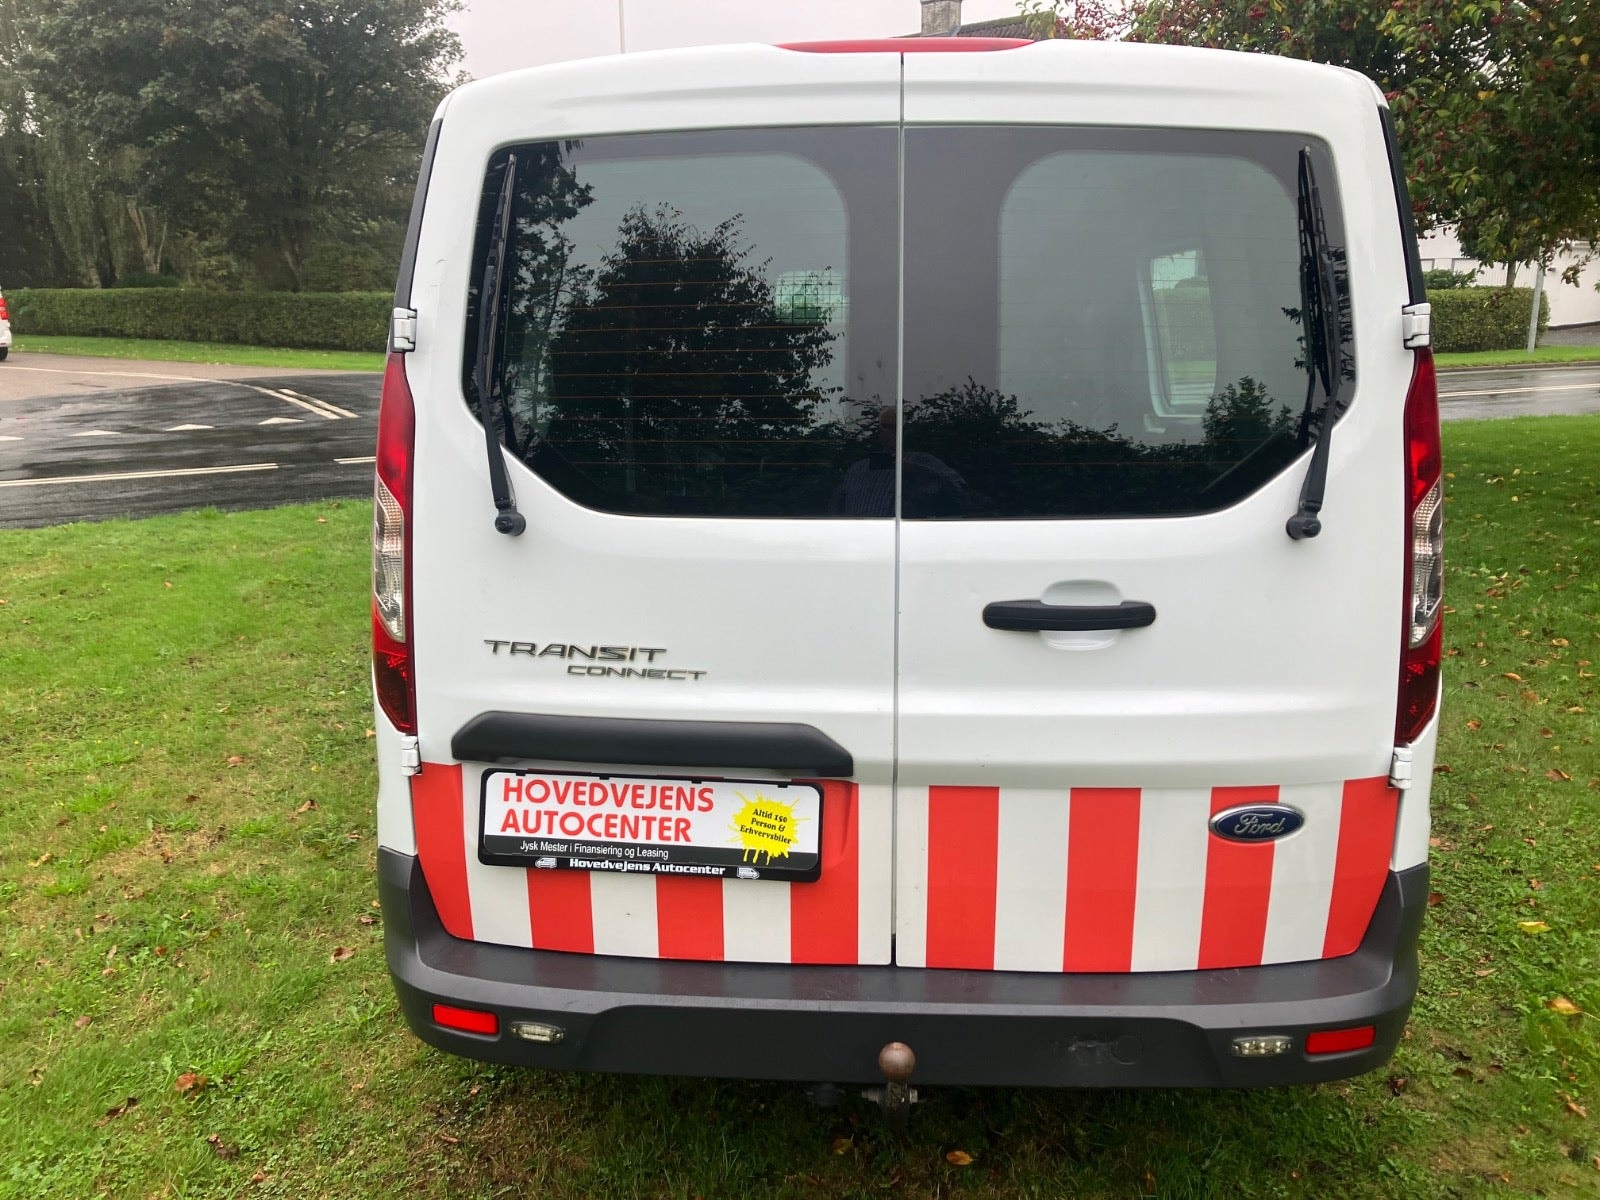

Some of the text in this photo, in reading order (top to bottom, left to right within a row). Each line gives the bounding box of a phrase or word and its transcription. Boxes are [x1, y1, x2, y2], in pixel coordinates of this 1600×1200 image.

[484, 639, 668, 663] TRANSIT
[567, 664, 708, 682] CONNECT
[502, 777, 715, 813] HOVEDVEJENS
[500, 808, 693, 843] AUTOCENTER
[751, 817, 777, 831] Person
[753, 808, 788, 823] Altid 150
[1233, 812, 1287, 836] Ford
[740, 824, 792, 844] Erhvervsbiler
[520, 840, 669, 861] Jysk Mester i Finansiering og Leasing
[569, 858, 726, 875] Hovedvejens Autocenter
